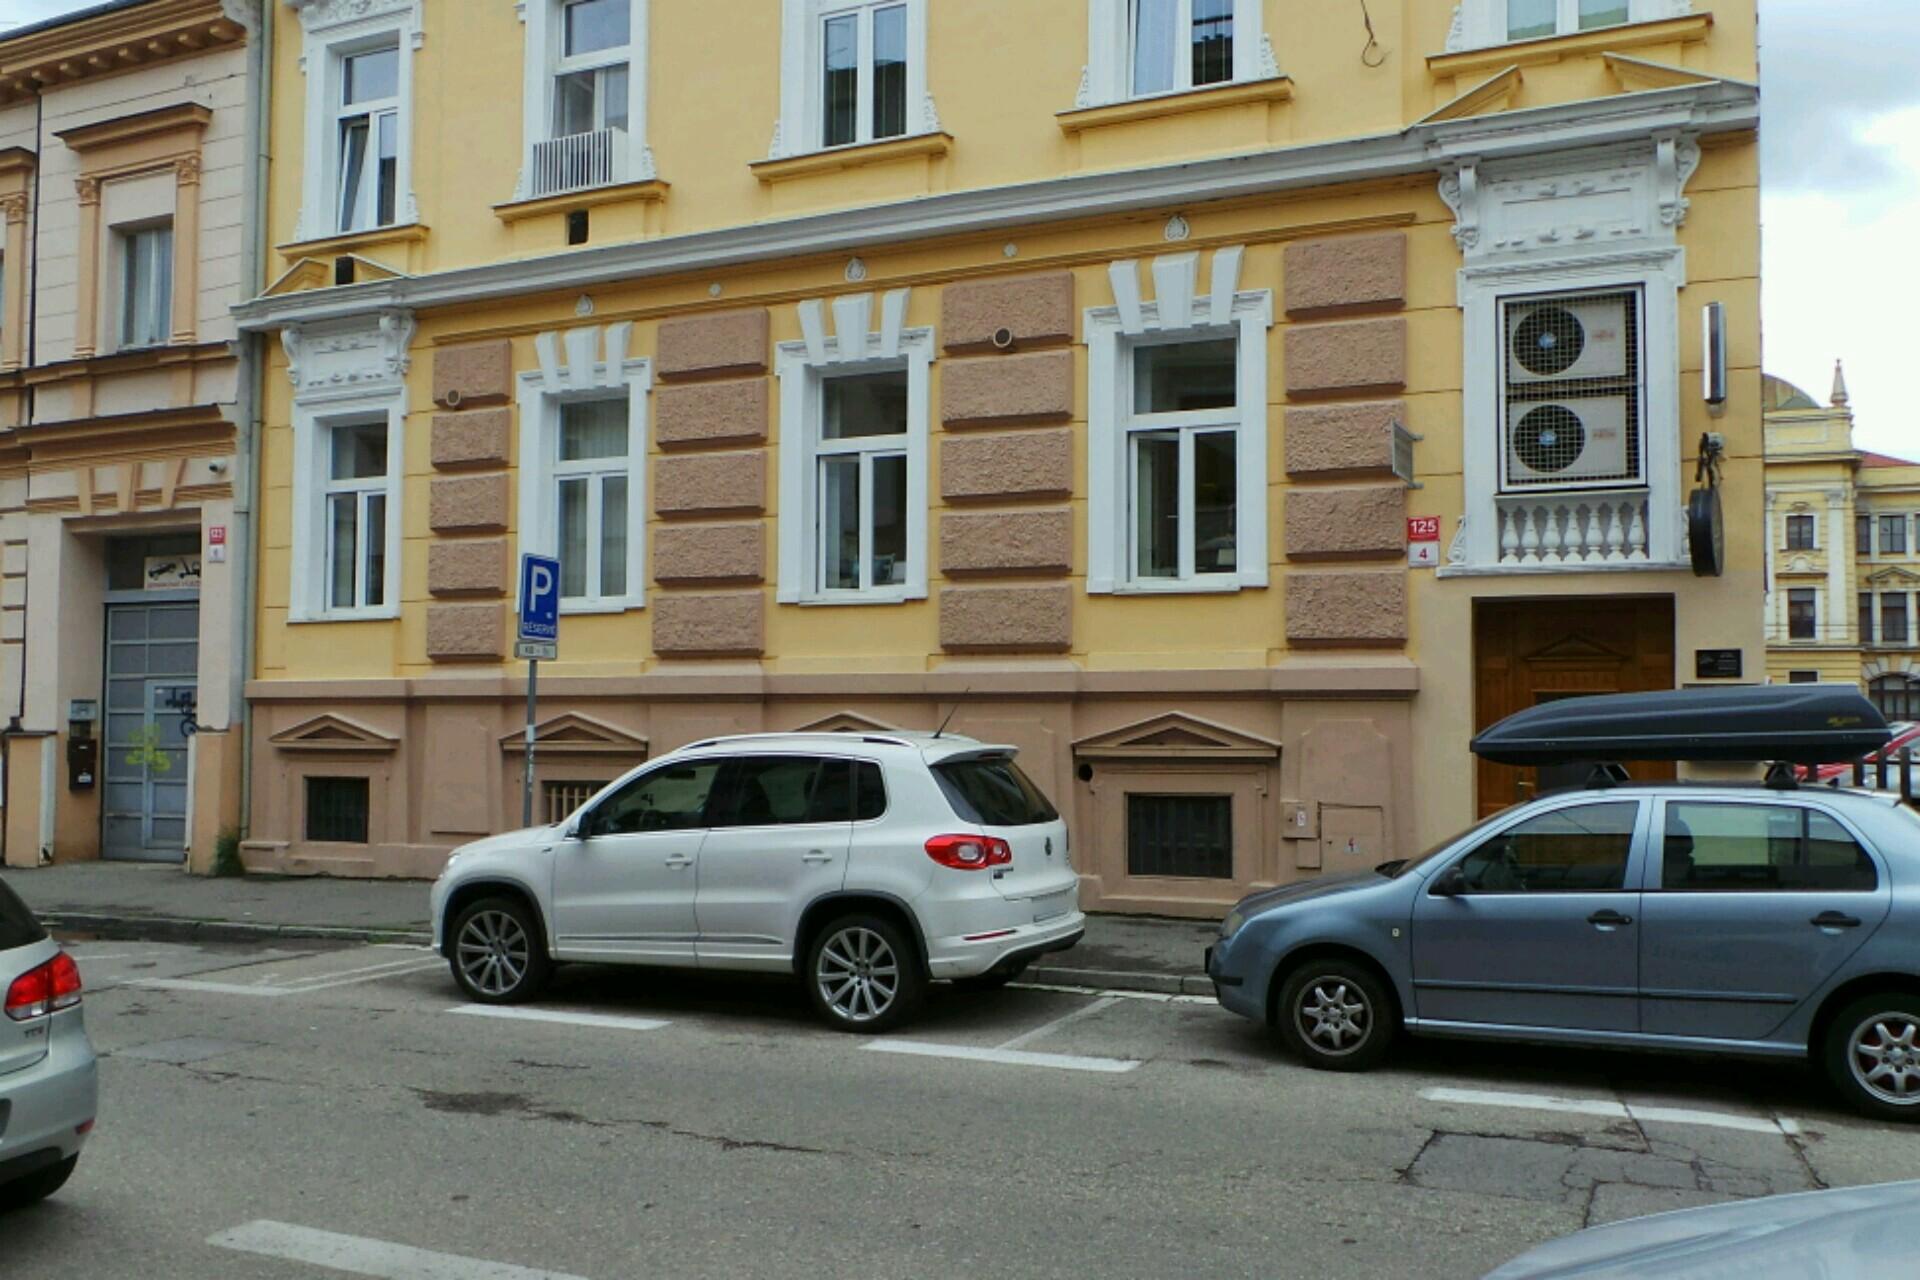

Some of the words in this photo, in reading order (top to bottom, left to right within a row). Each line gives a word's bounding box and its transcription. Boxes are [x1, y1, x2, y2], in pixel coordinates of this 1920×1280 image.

[1410, 519, 1437, 534] 125
[1419, 547, 1428, 560] 4
[529, 565, 553, 612] P
